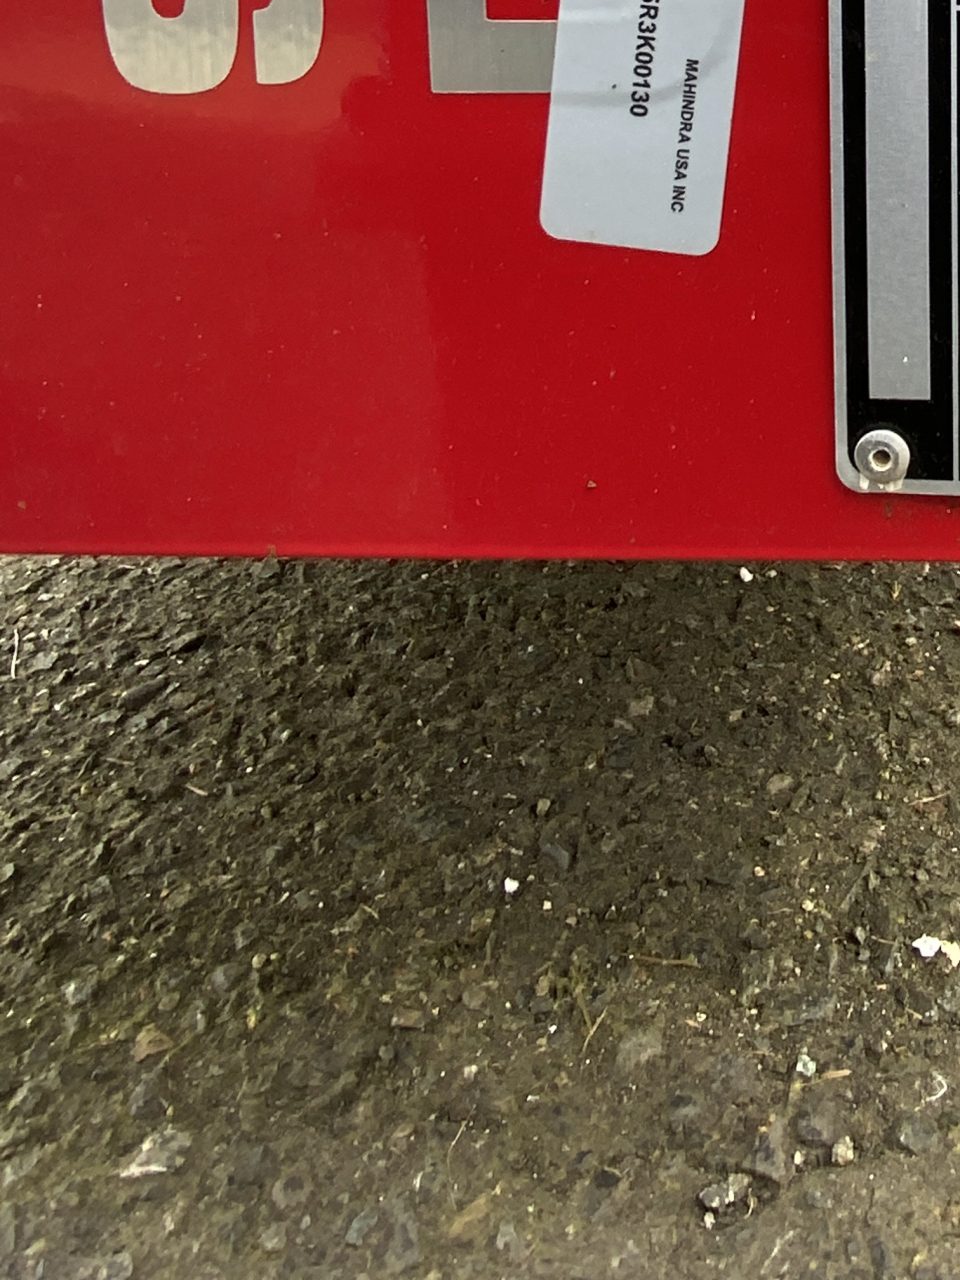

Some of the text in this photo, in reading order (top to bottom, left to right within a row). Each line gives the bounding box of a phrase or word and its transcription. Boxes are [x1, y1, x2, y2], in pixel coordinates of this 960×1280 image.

[670, 57, 700, 214] MAHINDRA USA INC
